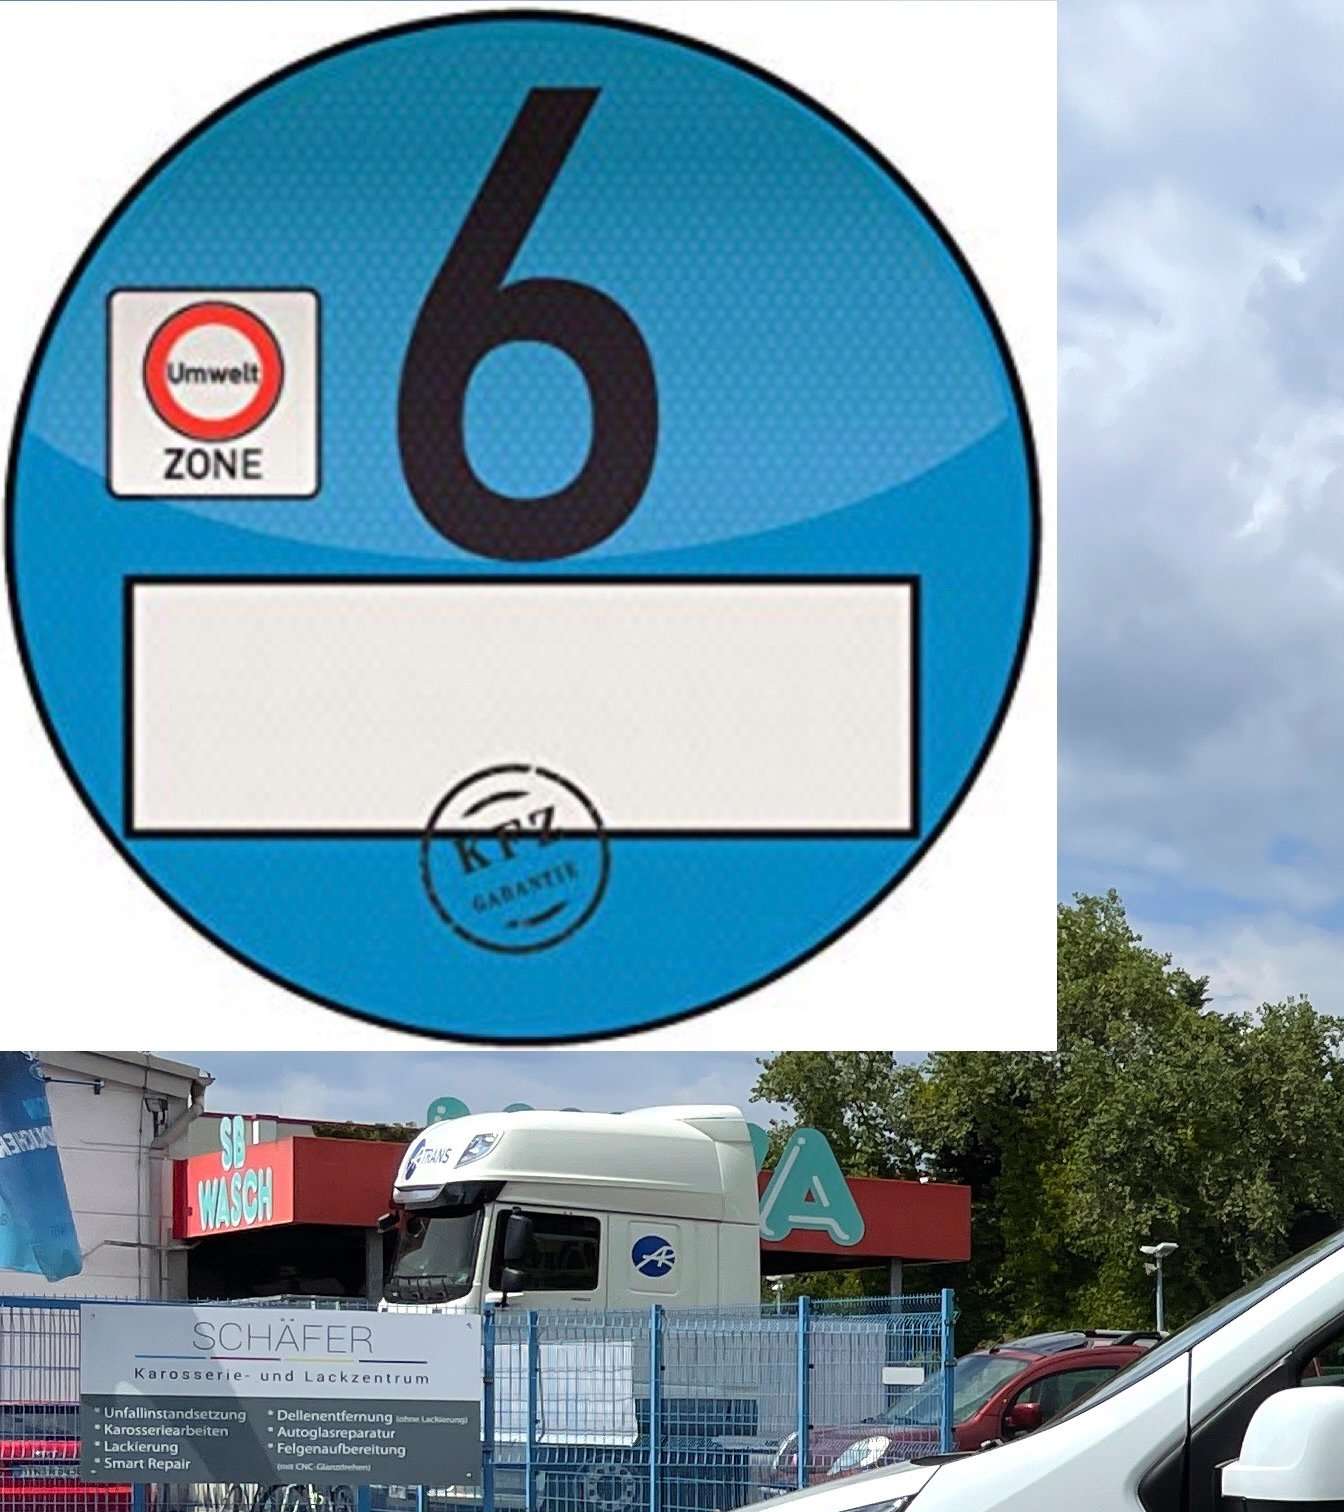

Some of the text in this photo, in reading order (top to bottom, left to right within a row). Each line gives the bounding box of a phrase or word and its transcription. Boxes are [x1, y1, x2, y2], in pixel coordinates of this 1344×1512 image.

[219, 1115, 245, 1171] SB
[198, 1167, 273, 1232] WASCH
[193, 1318, 373, 1353] SCHÄFER
[134, 1367, 430, 1385] Karosserie- und Lackzentrum
[104, 1407, 247, 1423] Unfallinstandsetzung
[277, 1409, 393, 1425] Dellenentfernung
[104, 1424, 229, 1437] Karosseriearbeiten
[277, 1426, 396, 1440] Autoglasreparatur
[104, 1440, 179, 1455] Lackierung
[277, 1443, 407, 1457] Felgenaufbereitung
[104, 1457, 191, 1472] Smart Repair
